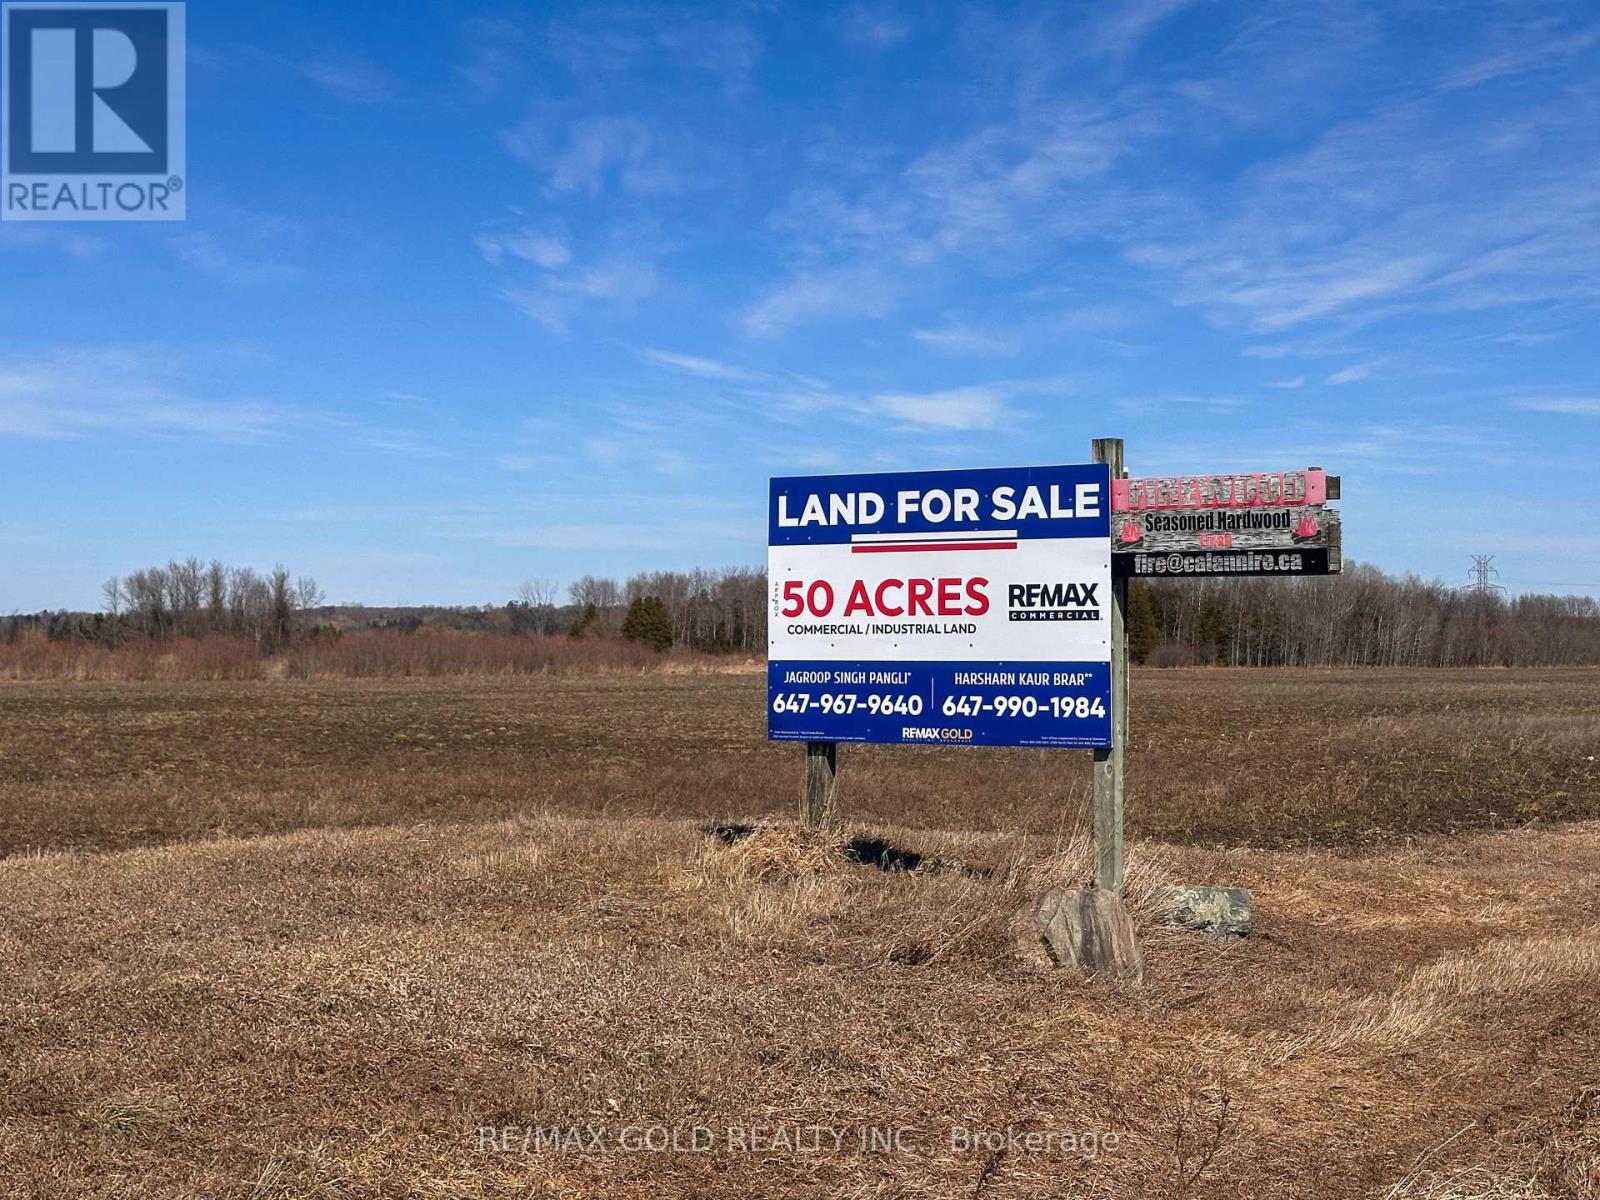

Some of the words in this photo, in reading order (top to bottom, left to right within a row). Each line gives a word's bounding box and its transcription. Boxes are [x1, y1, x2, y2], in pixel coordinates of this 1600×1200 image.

[778, 492, 885, 528] LAND
[897, 488, 980, 524] FOR
[991, 483, 1100, 521] SALE
[1145, 511, 1214, 532] Seasoned
[1217, 508, 1291, 530] Hardwood
[781, 579, 835, 618] 50
[843, 577, 990, 617] ACRES
[1008, 582, 1100, 608] REMAX
[1011, 611, 1097, 620] COMMERCIAL
[787, 624, 864, 635] COMMERCIAL
[872, 623, 942, 635] INDUSTRIAL
[943, 623, 977, 634] LAND
[784, 671, 831, 684] JAGROOP
[833, 671, 866, 684] SINGH
[954, 672, 1016, 686] HARSHARN
[1019, 672, 1050, 686] KAUR
[773, 693, 923, 716] 647-967-9640
[942, 695, 1106, 718] 647-990-1984
[902, 727, 940, 739] REMAX
[941, 728, 973, 739] GOLD
